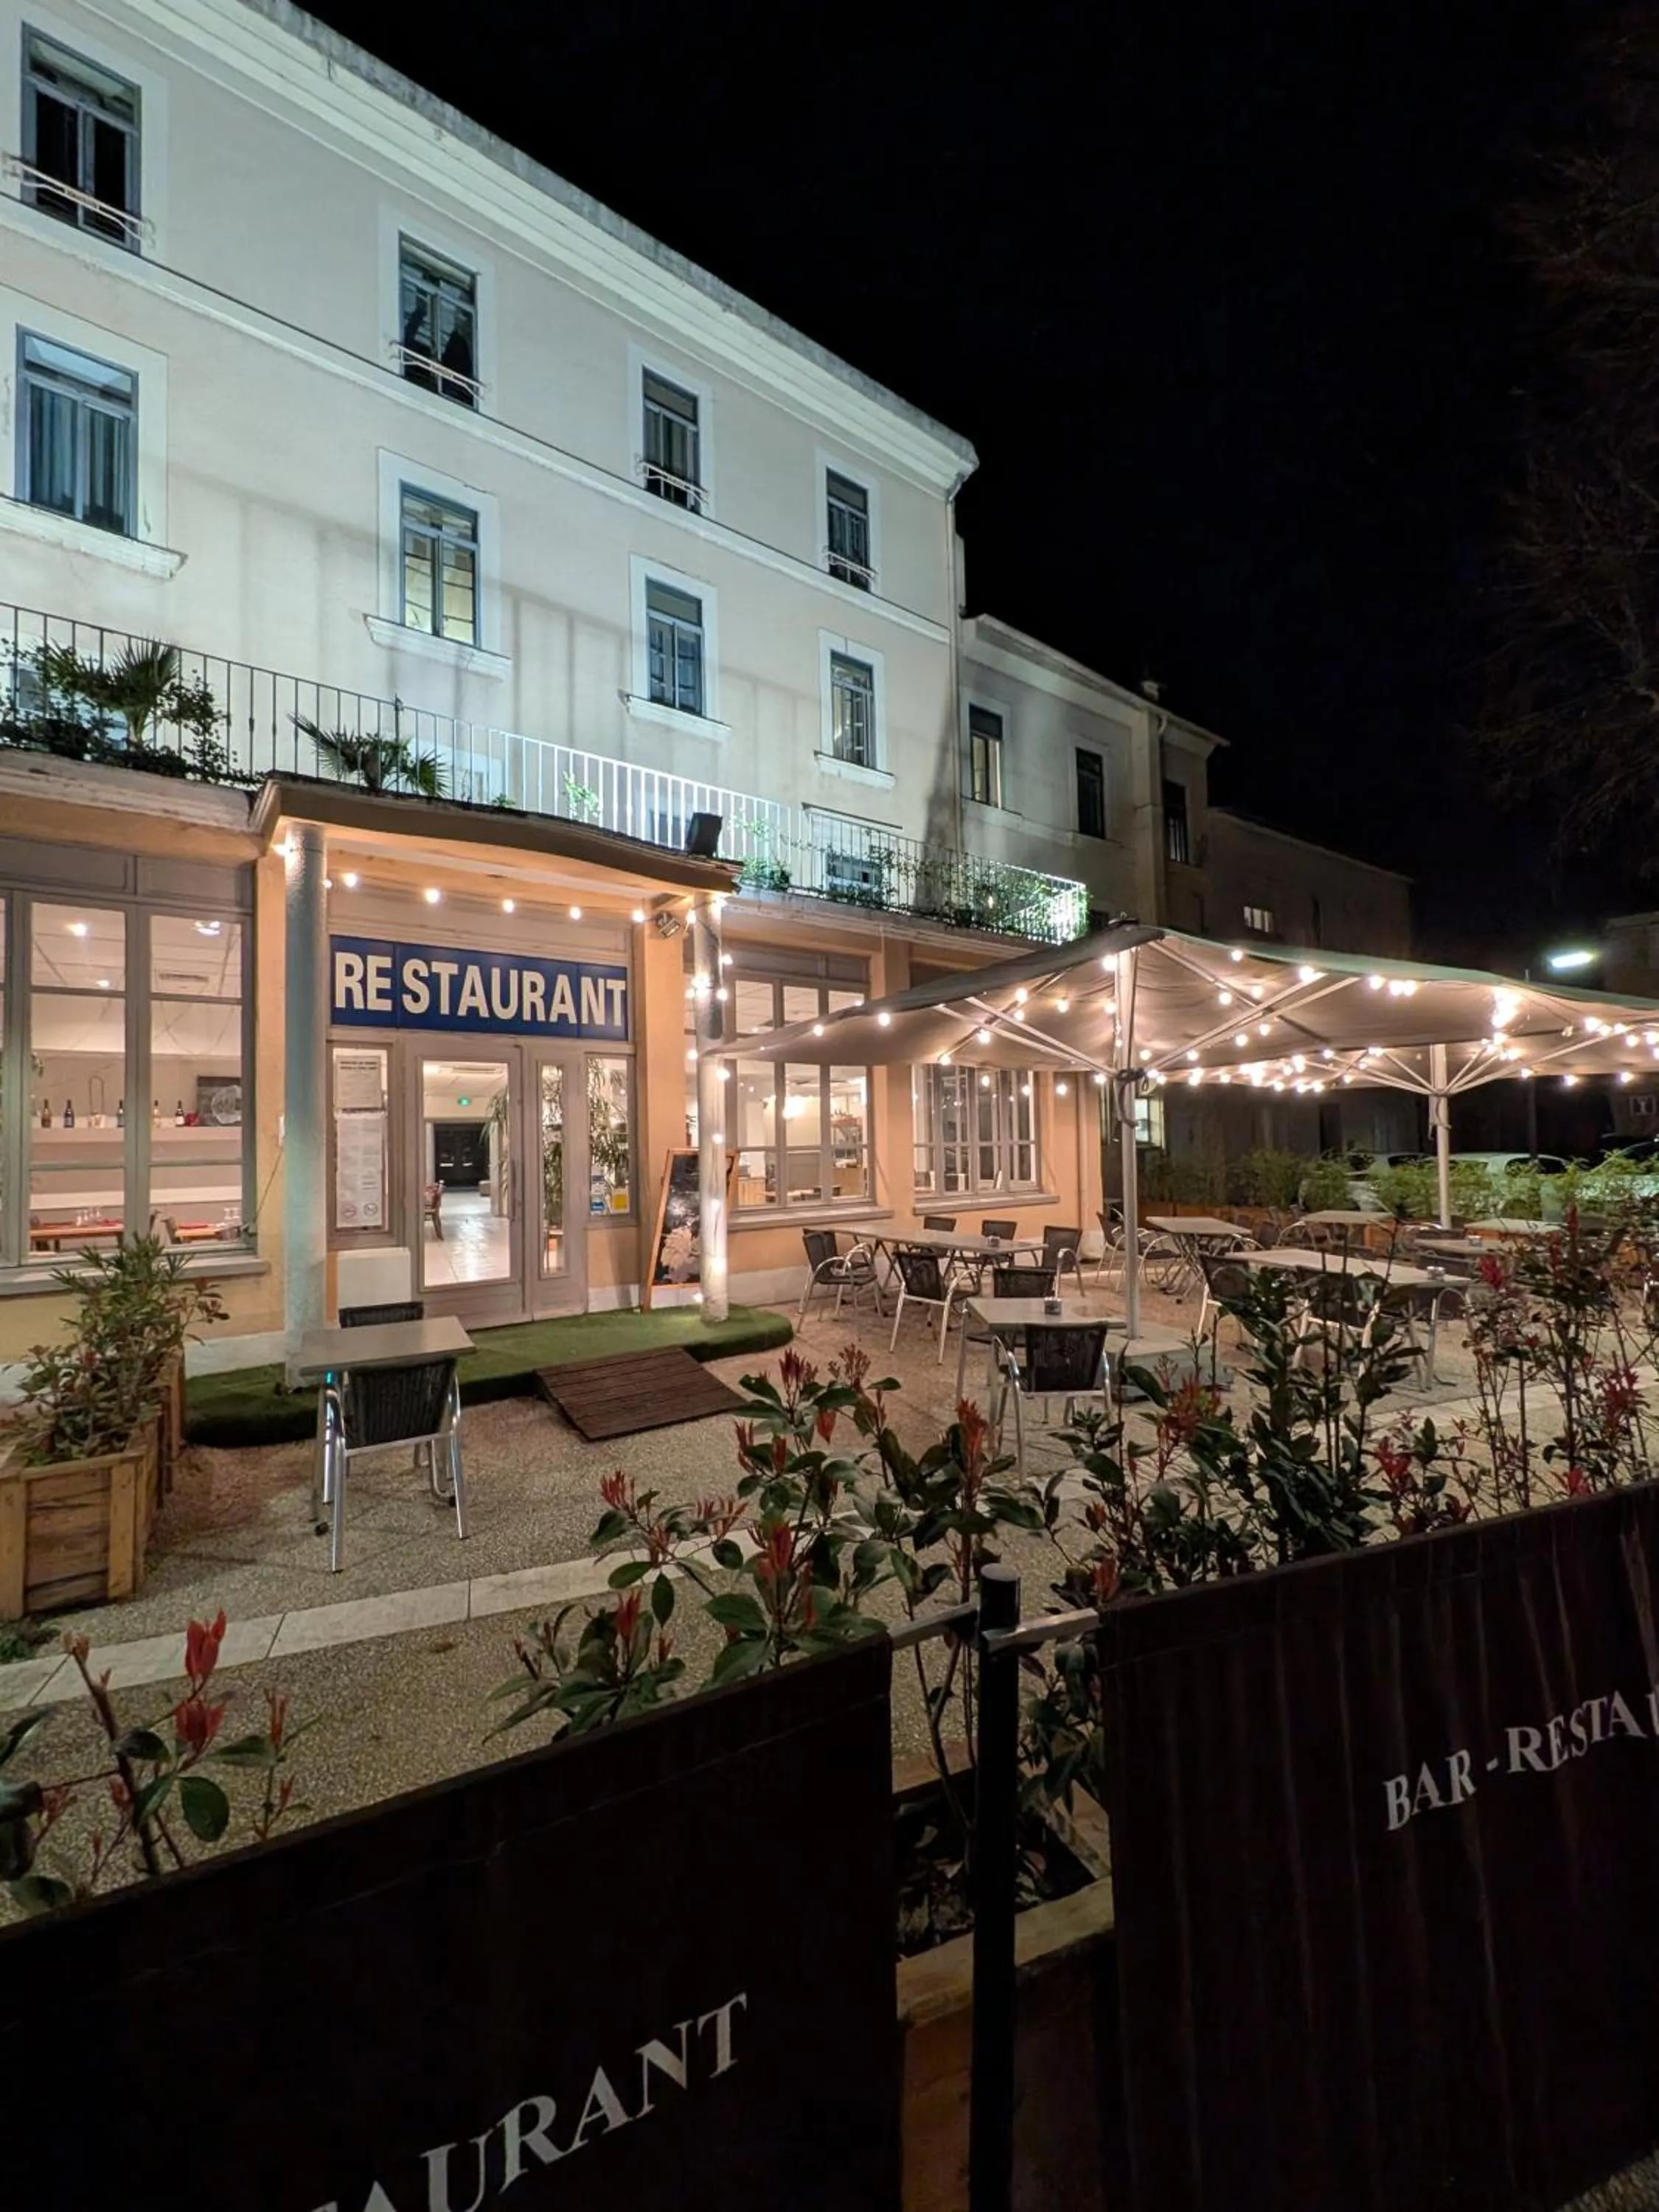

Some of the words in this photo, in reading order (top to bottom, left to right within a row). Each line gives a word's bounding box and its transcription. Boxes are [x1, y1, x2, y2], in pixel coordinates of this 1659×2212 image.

[334, 951, 627, 1027] RESTAURANT
[1382, 1749, 1477, 1831] BAR
[310, 1992, 748, 2212] URANT
